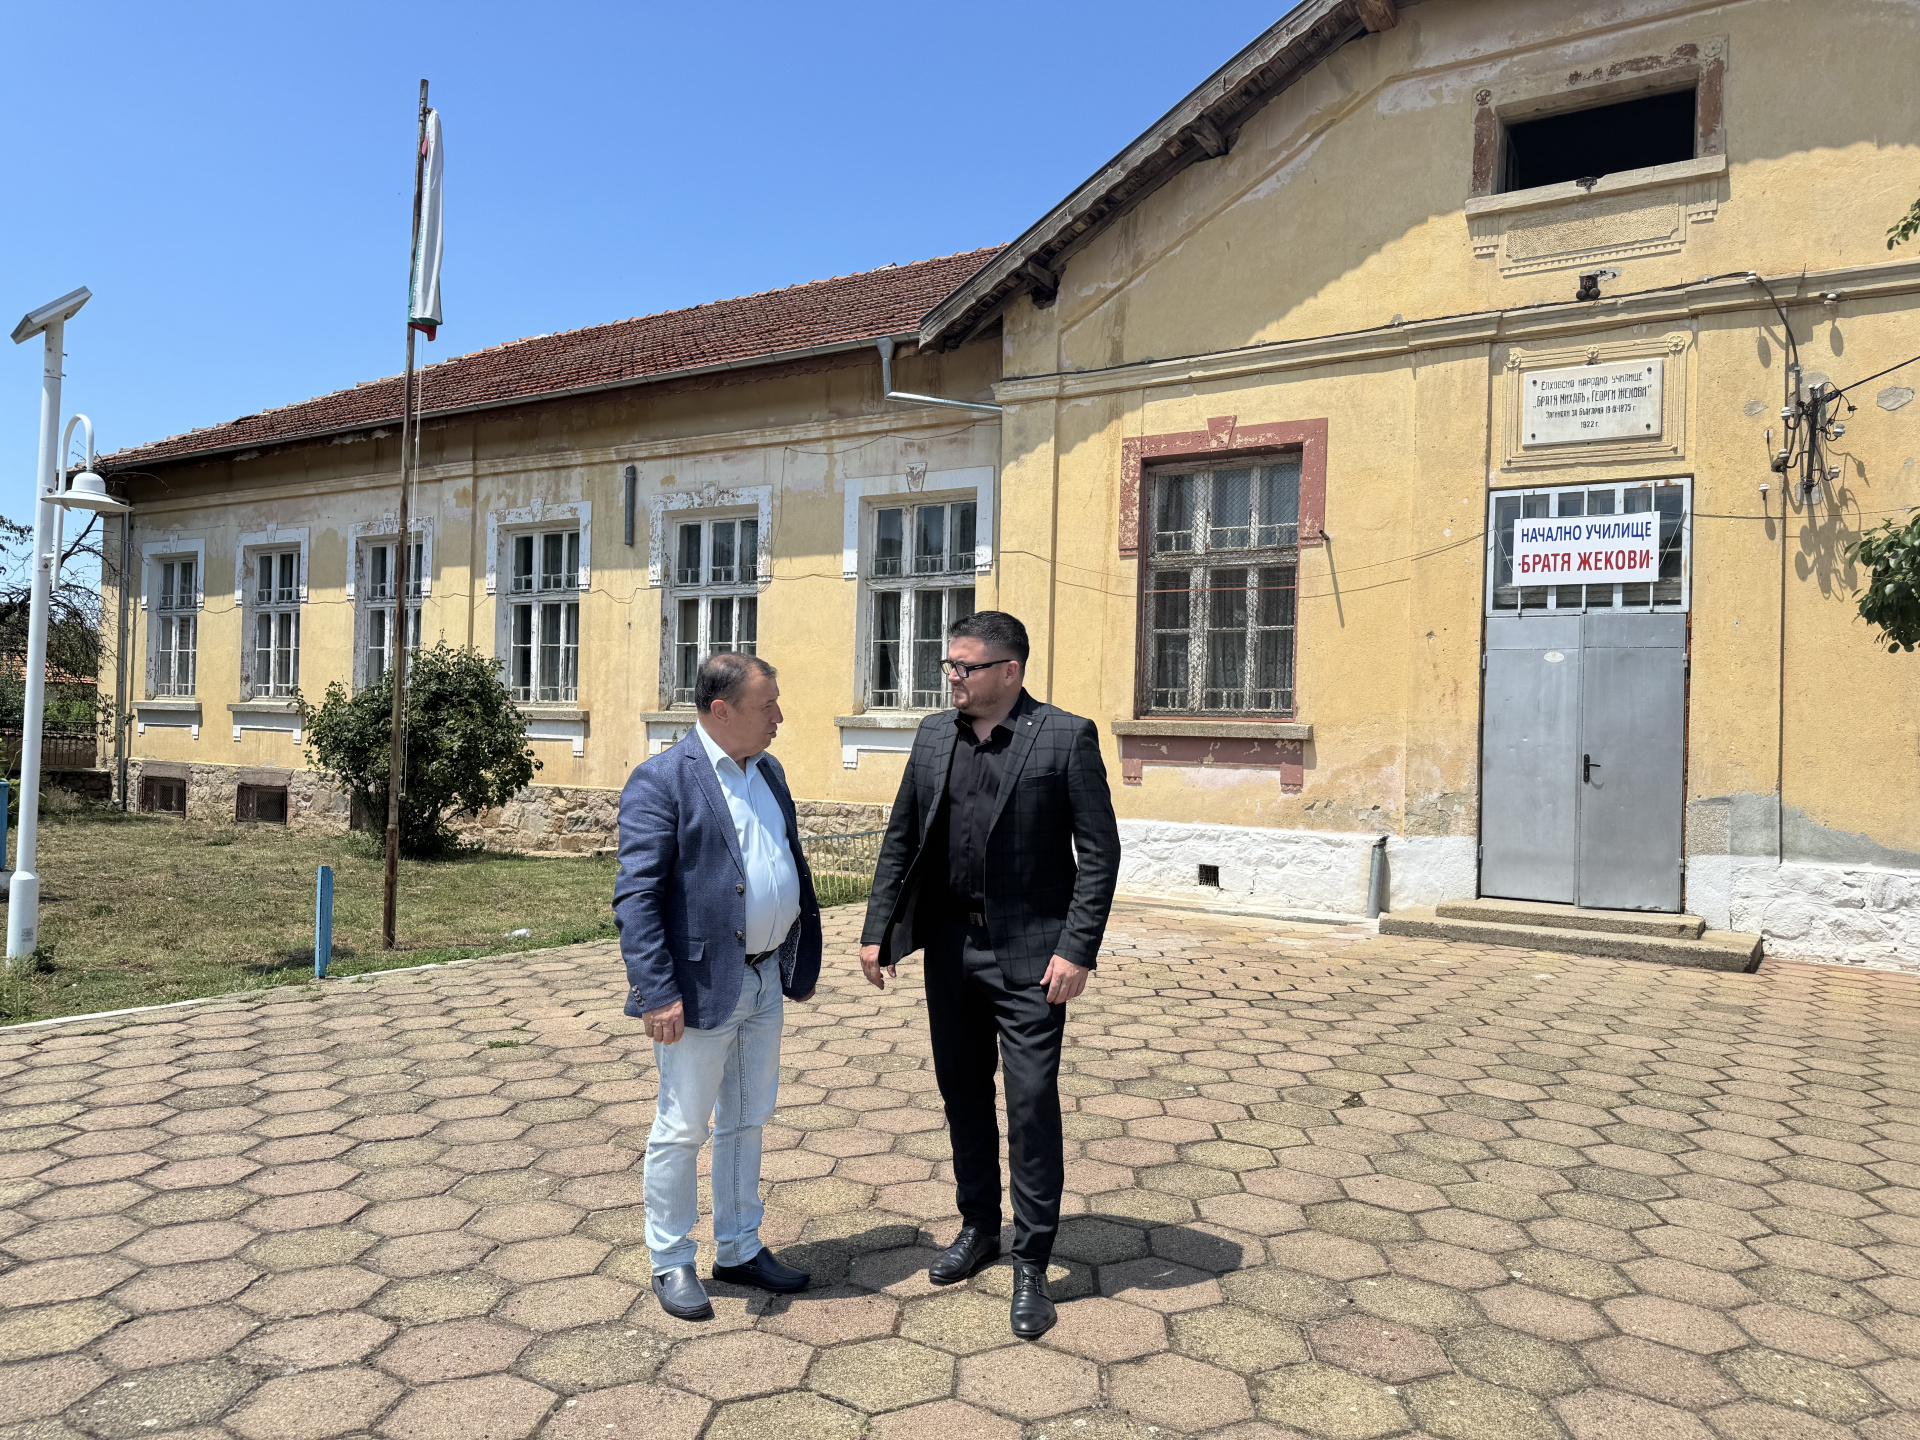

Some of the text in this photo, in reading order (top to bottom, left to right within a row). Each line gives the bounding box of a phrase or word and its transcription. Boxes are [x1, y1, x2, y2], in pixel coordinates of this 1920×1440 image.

[1578, 376, 1608, 387] НАРОДНО
[1611, 371, 1643, 384] УЧИЛИЩЕ
[1591, 389, 1616, 402] ГЕОРГИ
[1580, 420, 1595, 429] 1922
[1521, 521, 1652, 543] НАЧАЛНО УЧИЛИЩЕ
